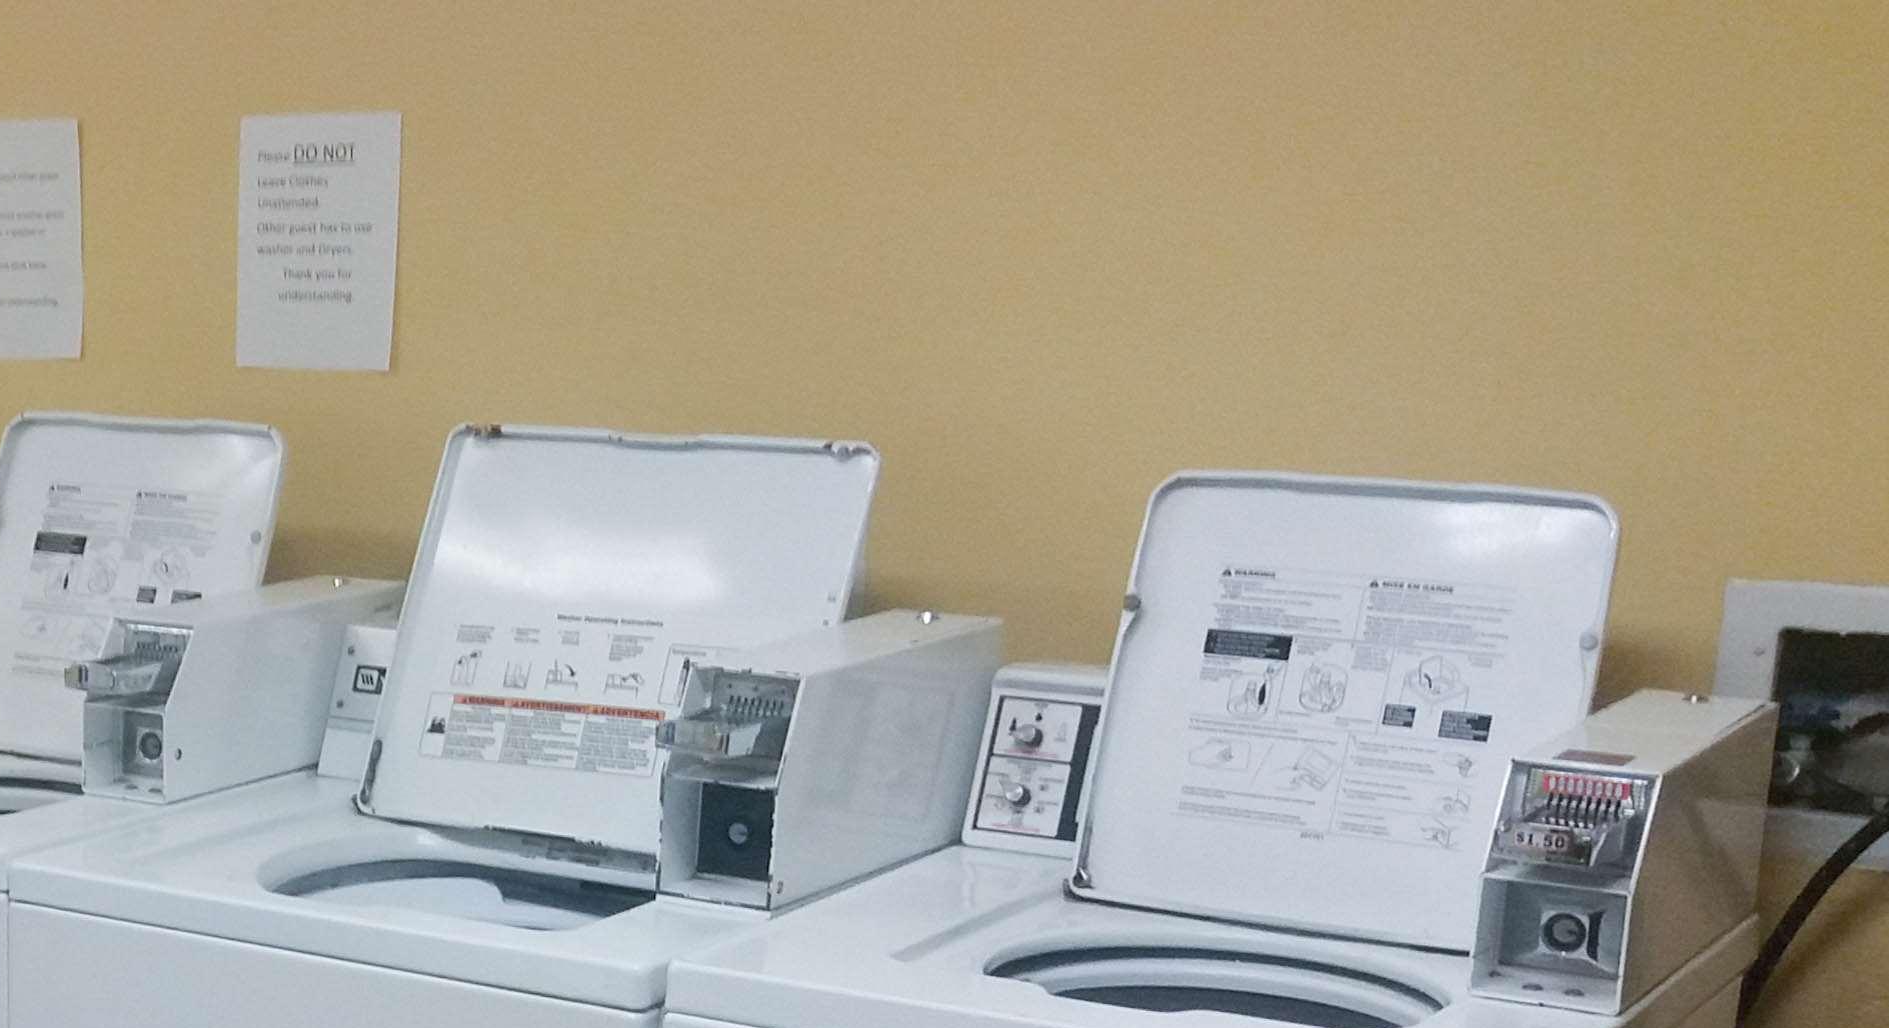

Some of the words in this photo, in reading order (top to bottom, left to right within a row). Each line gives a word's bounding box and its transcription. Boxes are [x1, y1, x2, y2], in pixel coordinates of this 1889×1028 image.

[293, 143, 318, 163] DO
[322, 143, 355, 163] NOT
[256, 221, 285, 233] Other
[288, 222, 316, 235] guest
[296, 243, 315, 255] and
[282, 266, 312, 279] Thank
[315, 269, 335, 281] you
[337, 266, 353, 279] for
